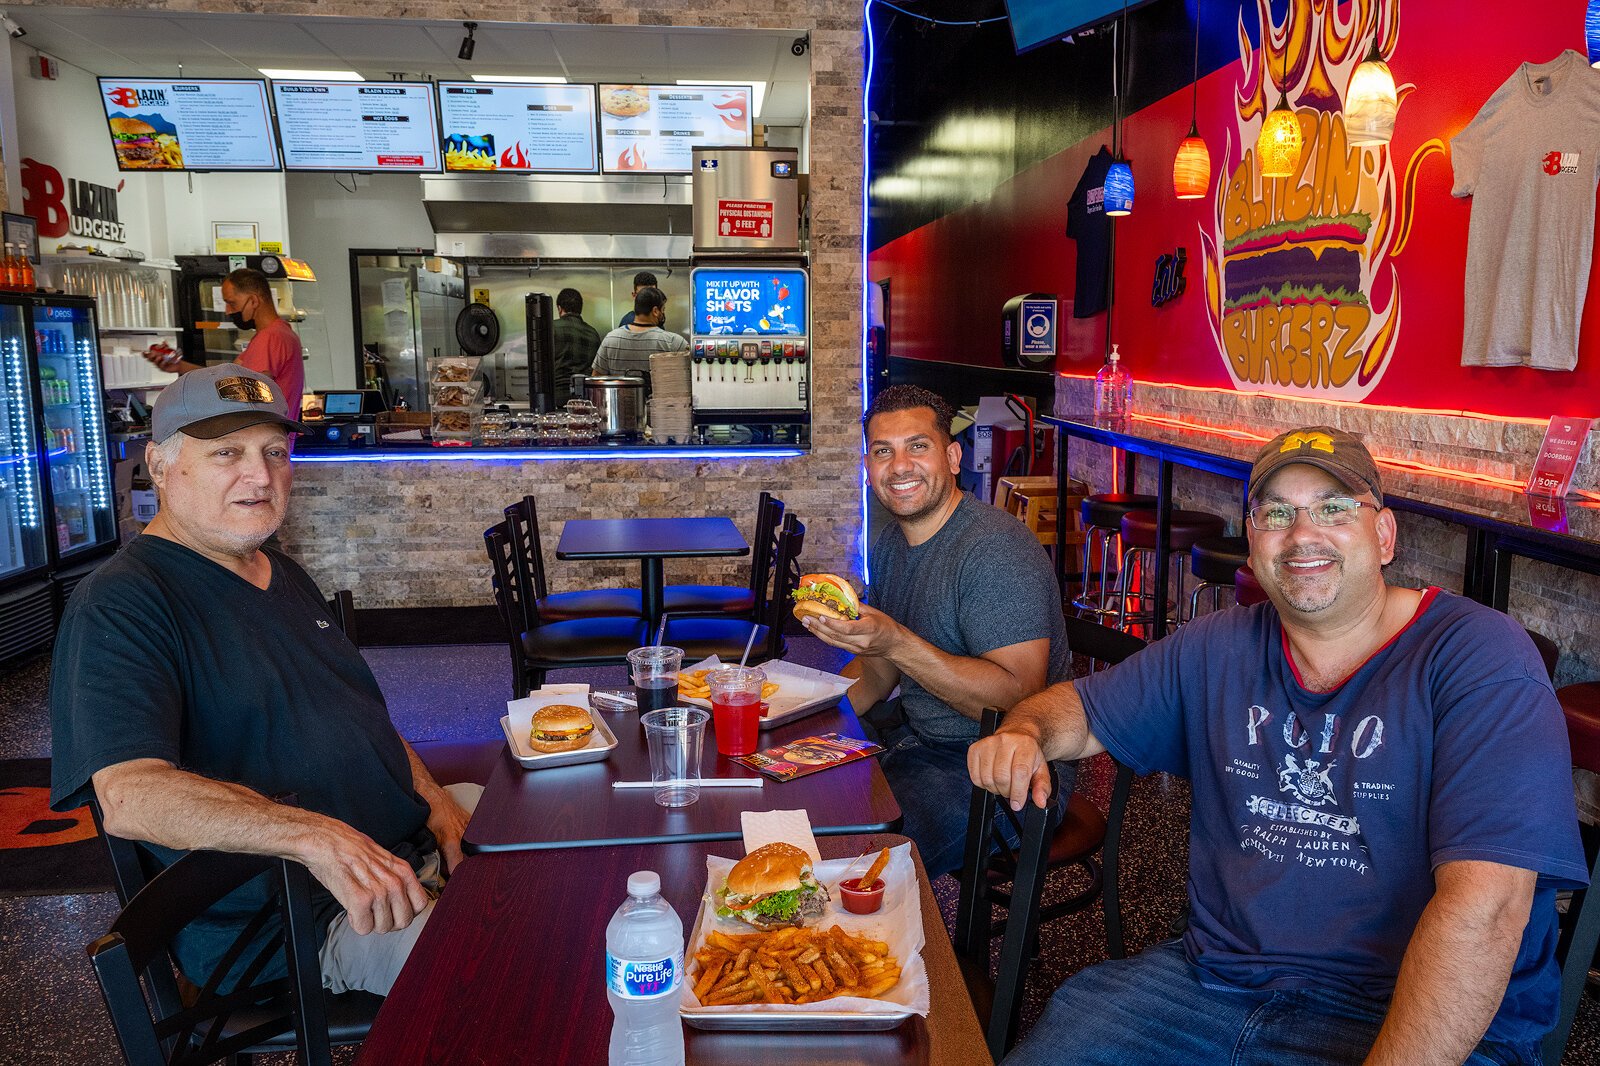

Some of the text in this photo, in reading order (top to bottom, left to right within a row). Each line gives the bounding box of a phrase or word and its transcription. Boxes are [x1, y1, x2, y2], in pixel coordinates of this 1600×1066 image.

[719, 209, 772, 218] PHYSICAL DISTANCING
[735, 220, 756, 229] 6 FEET
[706, 280, 720, 288] MIX
[706, 288, 760, 300] FLAVOR
[705, 300, 752, 312] SHOTS
[1221, 302, 1372, 390] BURGERZ
[1280, 432, 1335, 453] M
[1558, 438, 1577, 446] DELIVER
[1543, 452, 1573, 461] DOORDASH
[1544, 478, 1559, 488] OFF
[1233, 758, 1261, 770] QUALITY
[1235, 768, 1259, 779] GOODS
[1353, 781, 1359, 789] &
[1353, 791, 1390, 801] SUPPLIES
[1270, 824, 1318, 837] ESTABLISHED
[1253, 825, 1350, 851] RALPH LAUREN
[1296, 851, 1327, 868] NEW
[1330, 857, 1369, 875] YORK
[626, 967, 673, 984] Pure Life
